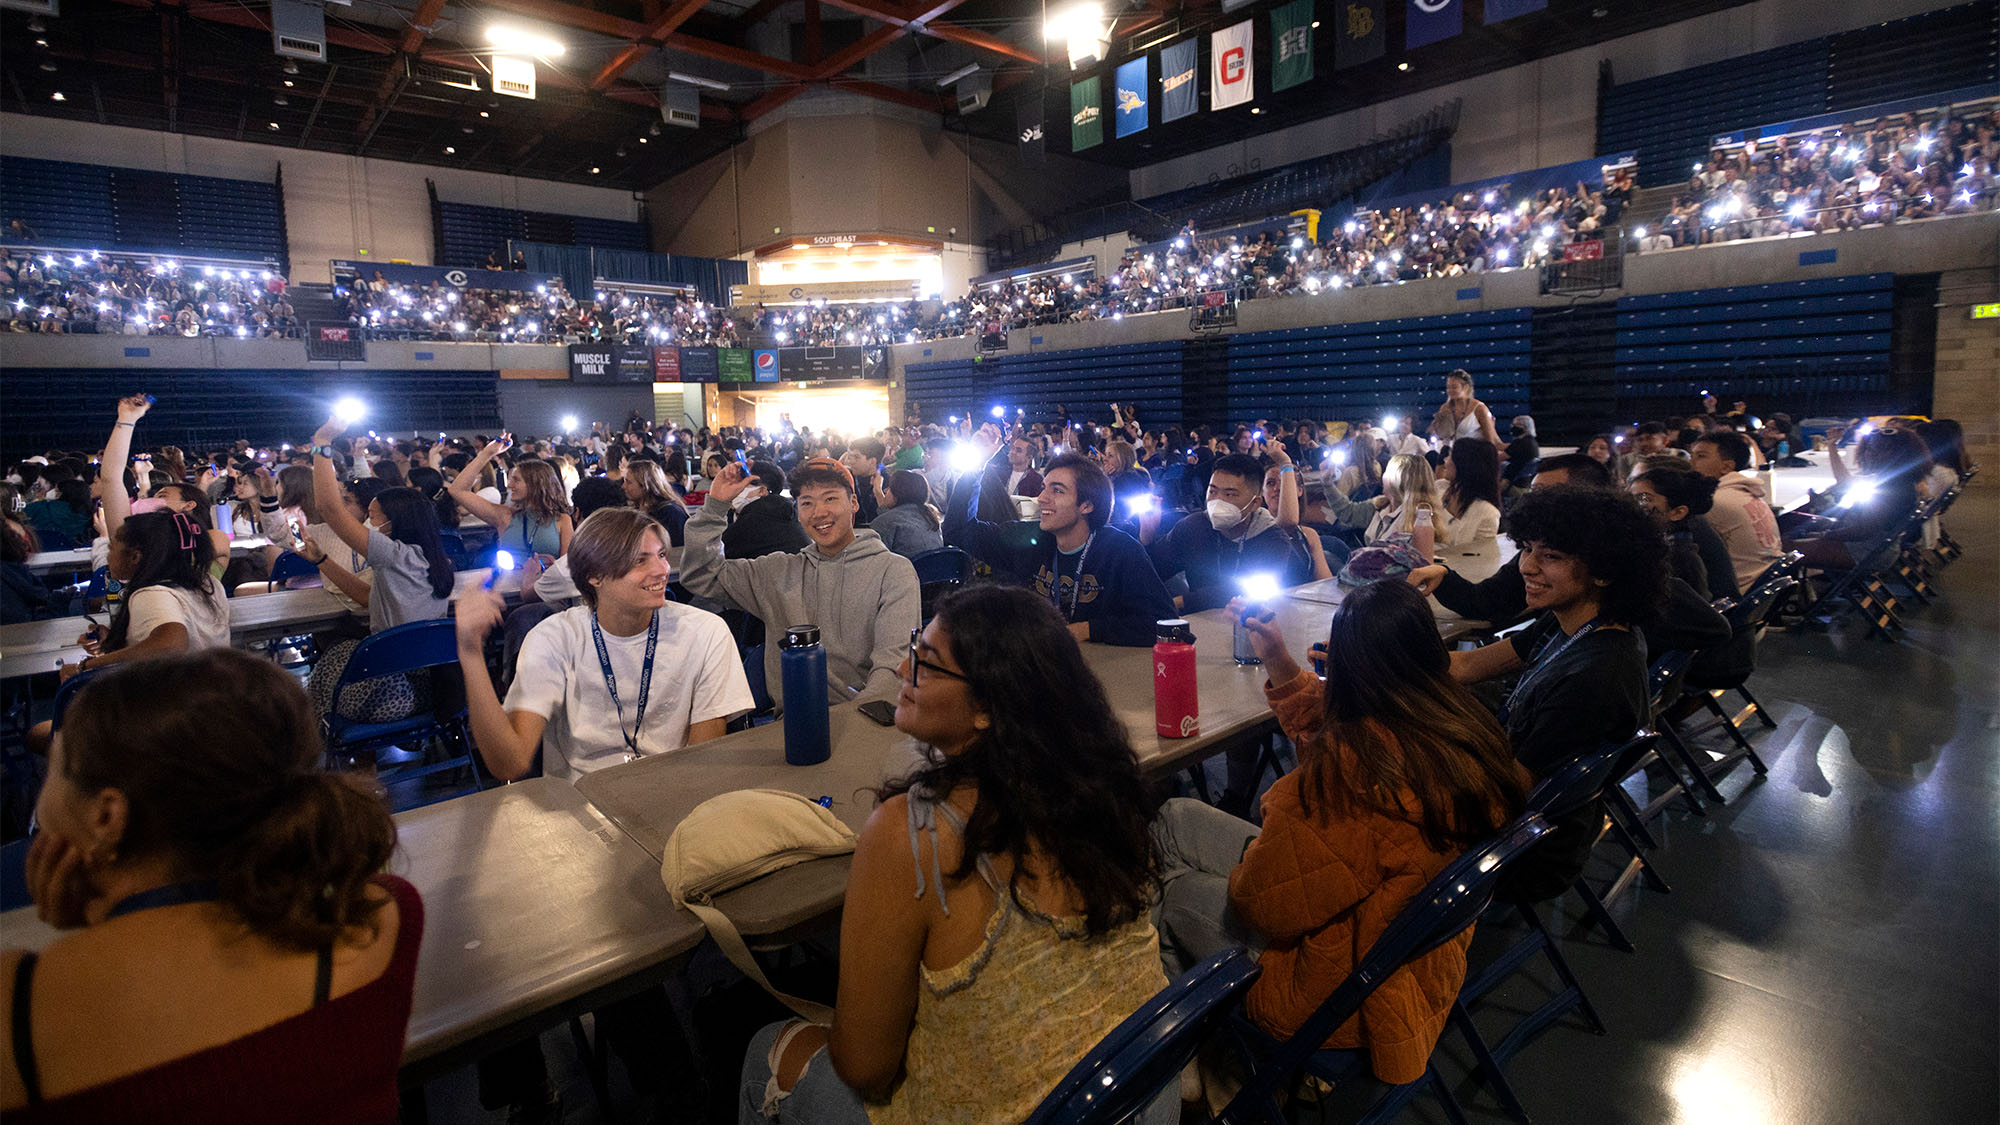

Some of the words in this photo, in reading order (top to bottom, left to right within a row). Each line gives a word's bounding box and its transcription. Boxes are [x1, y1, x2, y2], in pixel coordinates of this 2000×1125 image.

[814, 235, 856, 244] SOUTHEAST
[574, 353, 611, 365] MUSCLE
[582, 364, 605, 375] MILK
[594, 630, 609, 666] Orientation
[645, 640, 655, 660] Aggie
[640, 668, 650, 705] Orientation
